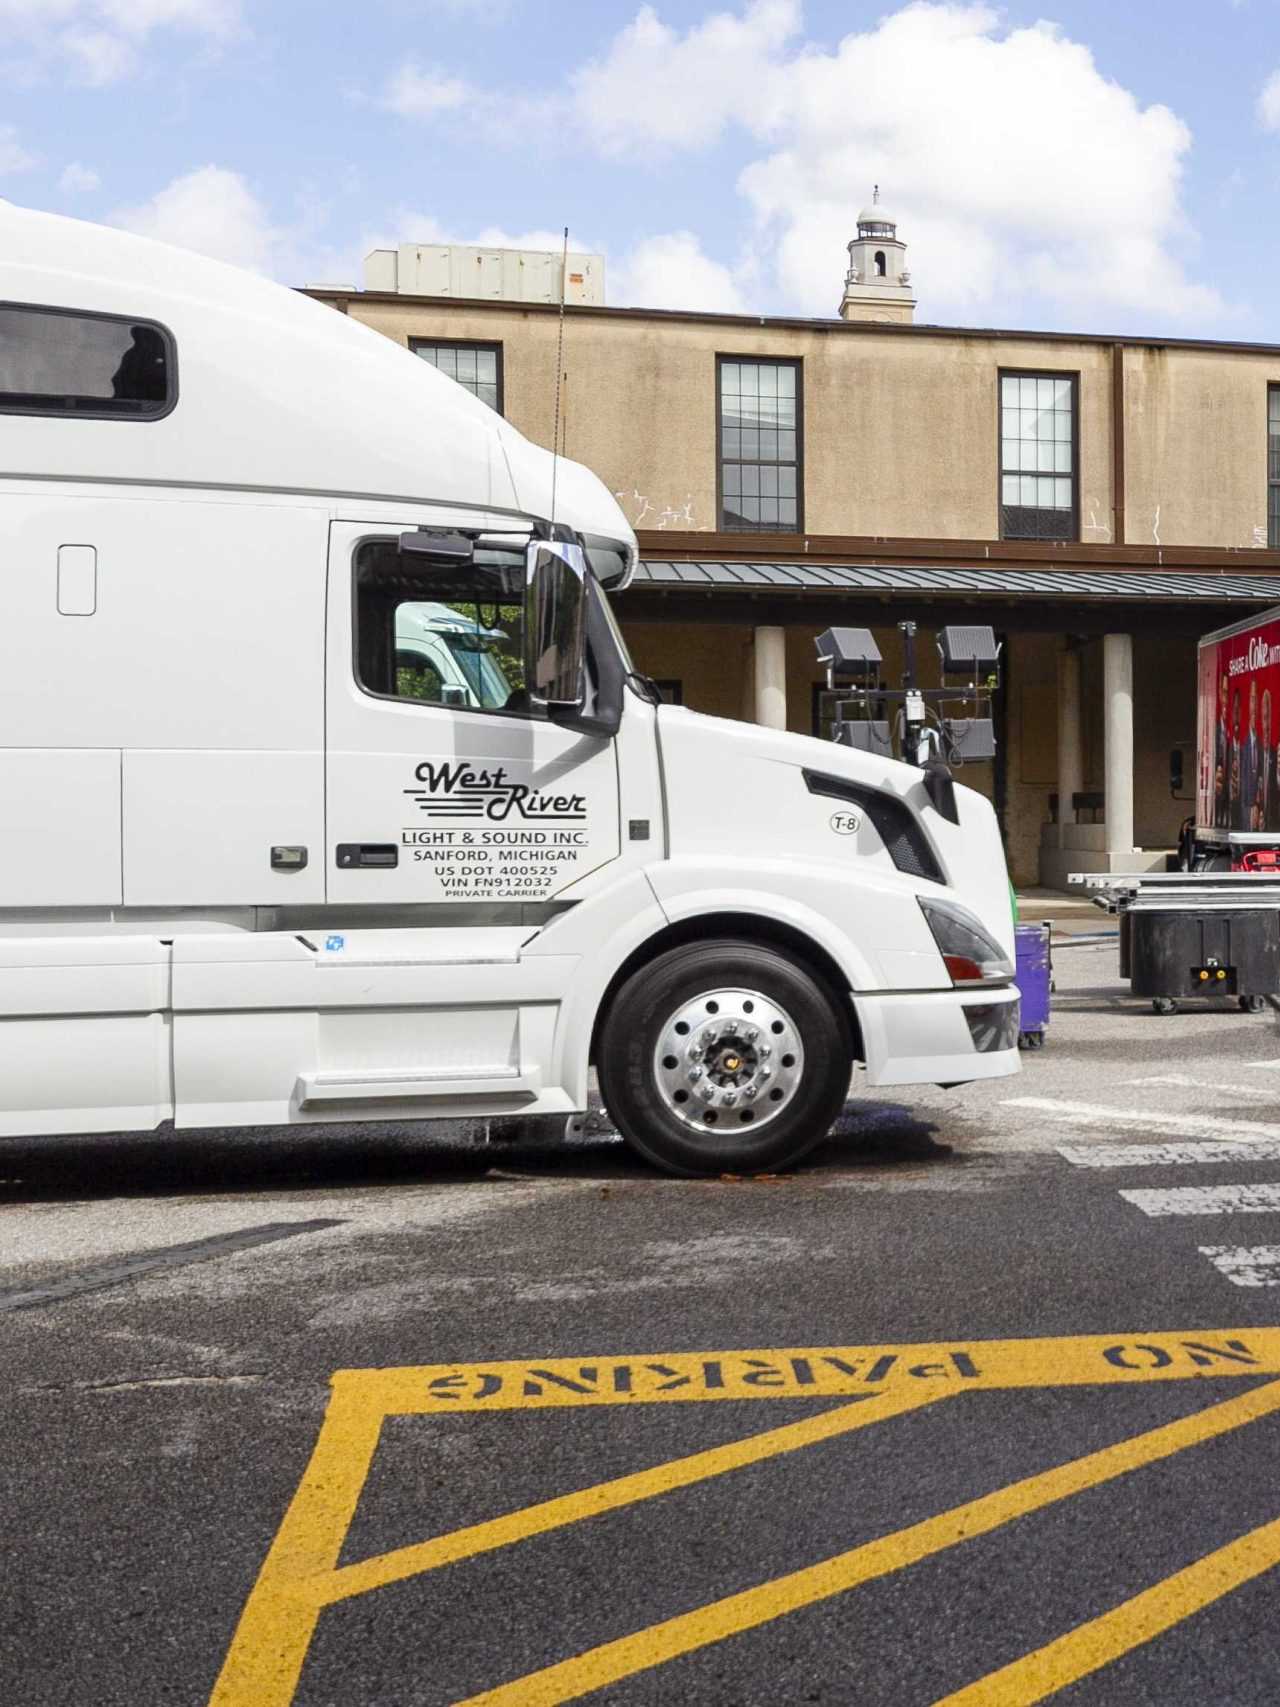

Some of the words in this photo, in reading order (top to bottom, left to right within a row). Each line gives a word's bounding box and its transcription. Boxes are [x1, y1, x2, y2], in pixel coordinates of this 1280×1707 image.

[1229, 656, 1245, 677] SHARE
[1249, 636, 1269, 671] Coke
[415, 762, 508, 793] West
[486, 783, 587, 821] River
[835, 816, 856, 830] T-8
[402, 832, 456, 844] LIGHT
[463, 832, 475, 844] &
[482, 832, 547, 844] SOUND
[554, 832, 590, 844] INC.
[413, 850, 493, 862] SANFORD,
[499, 850, 578, 861] MICHIGAN
[434, 866, 455, 876] US
[461, 866, 495, 876] DOT
[500, 866, 558, 876] 400525
[440, 878, 468, 888] VIN
[474, 878, 553, 887] FN912032
[497, 889, 548, 897] CARRIER
[1102, 1339, 1262, 1370] NO
[428, 1351, 983, 1400] PARKING
